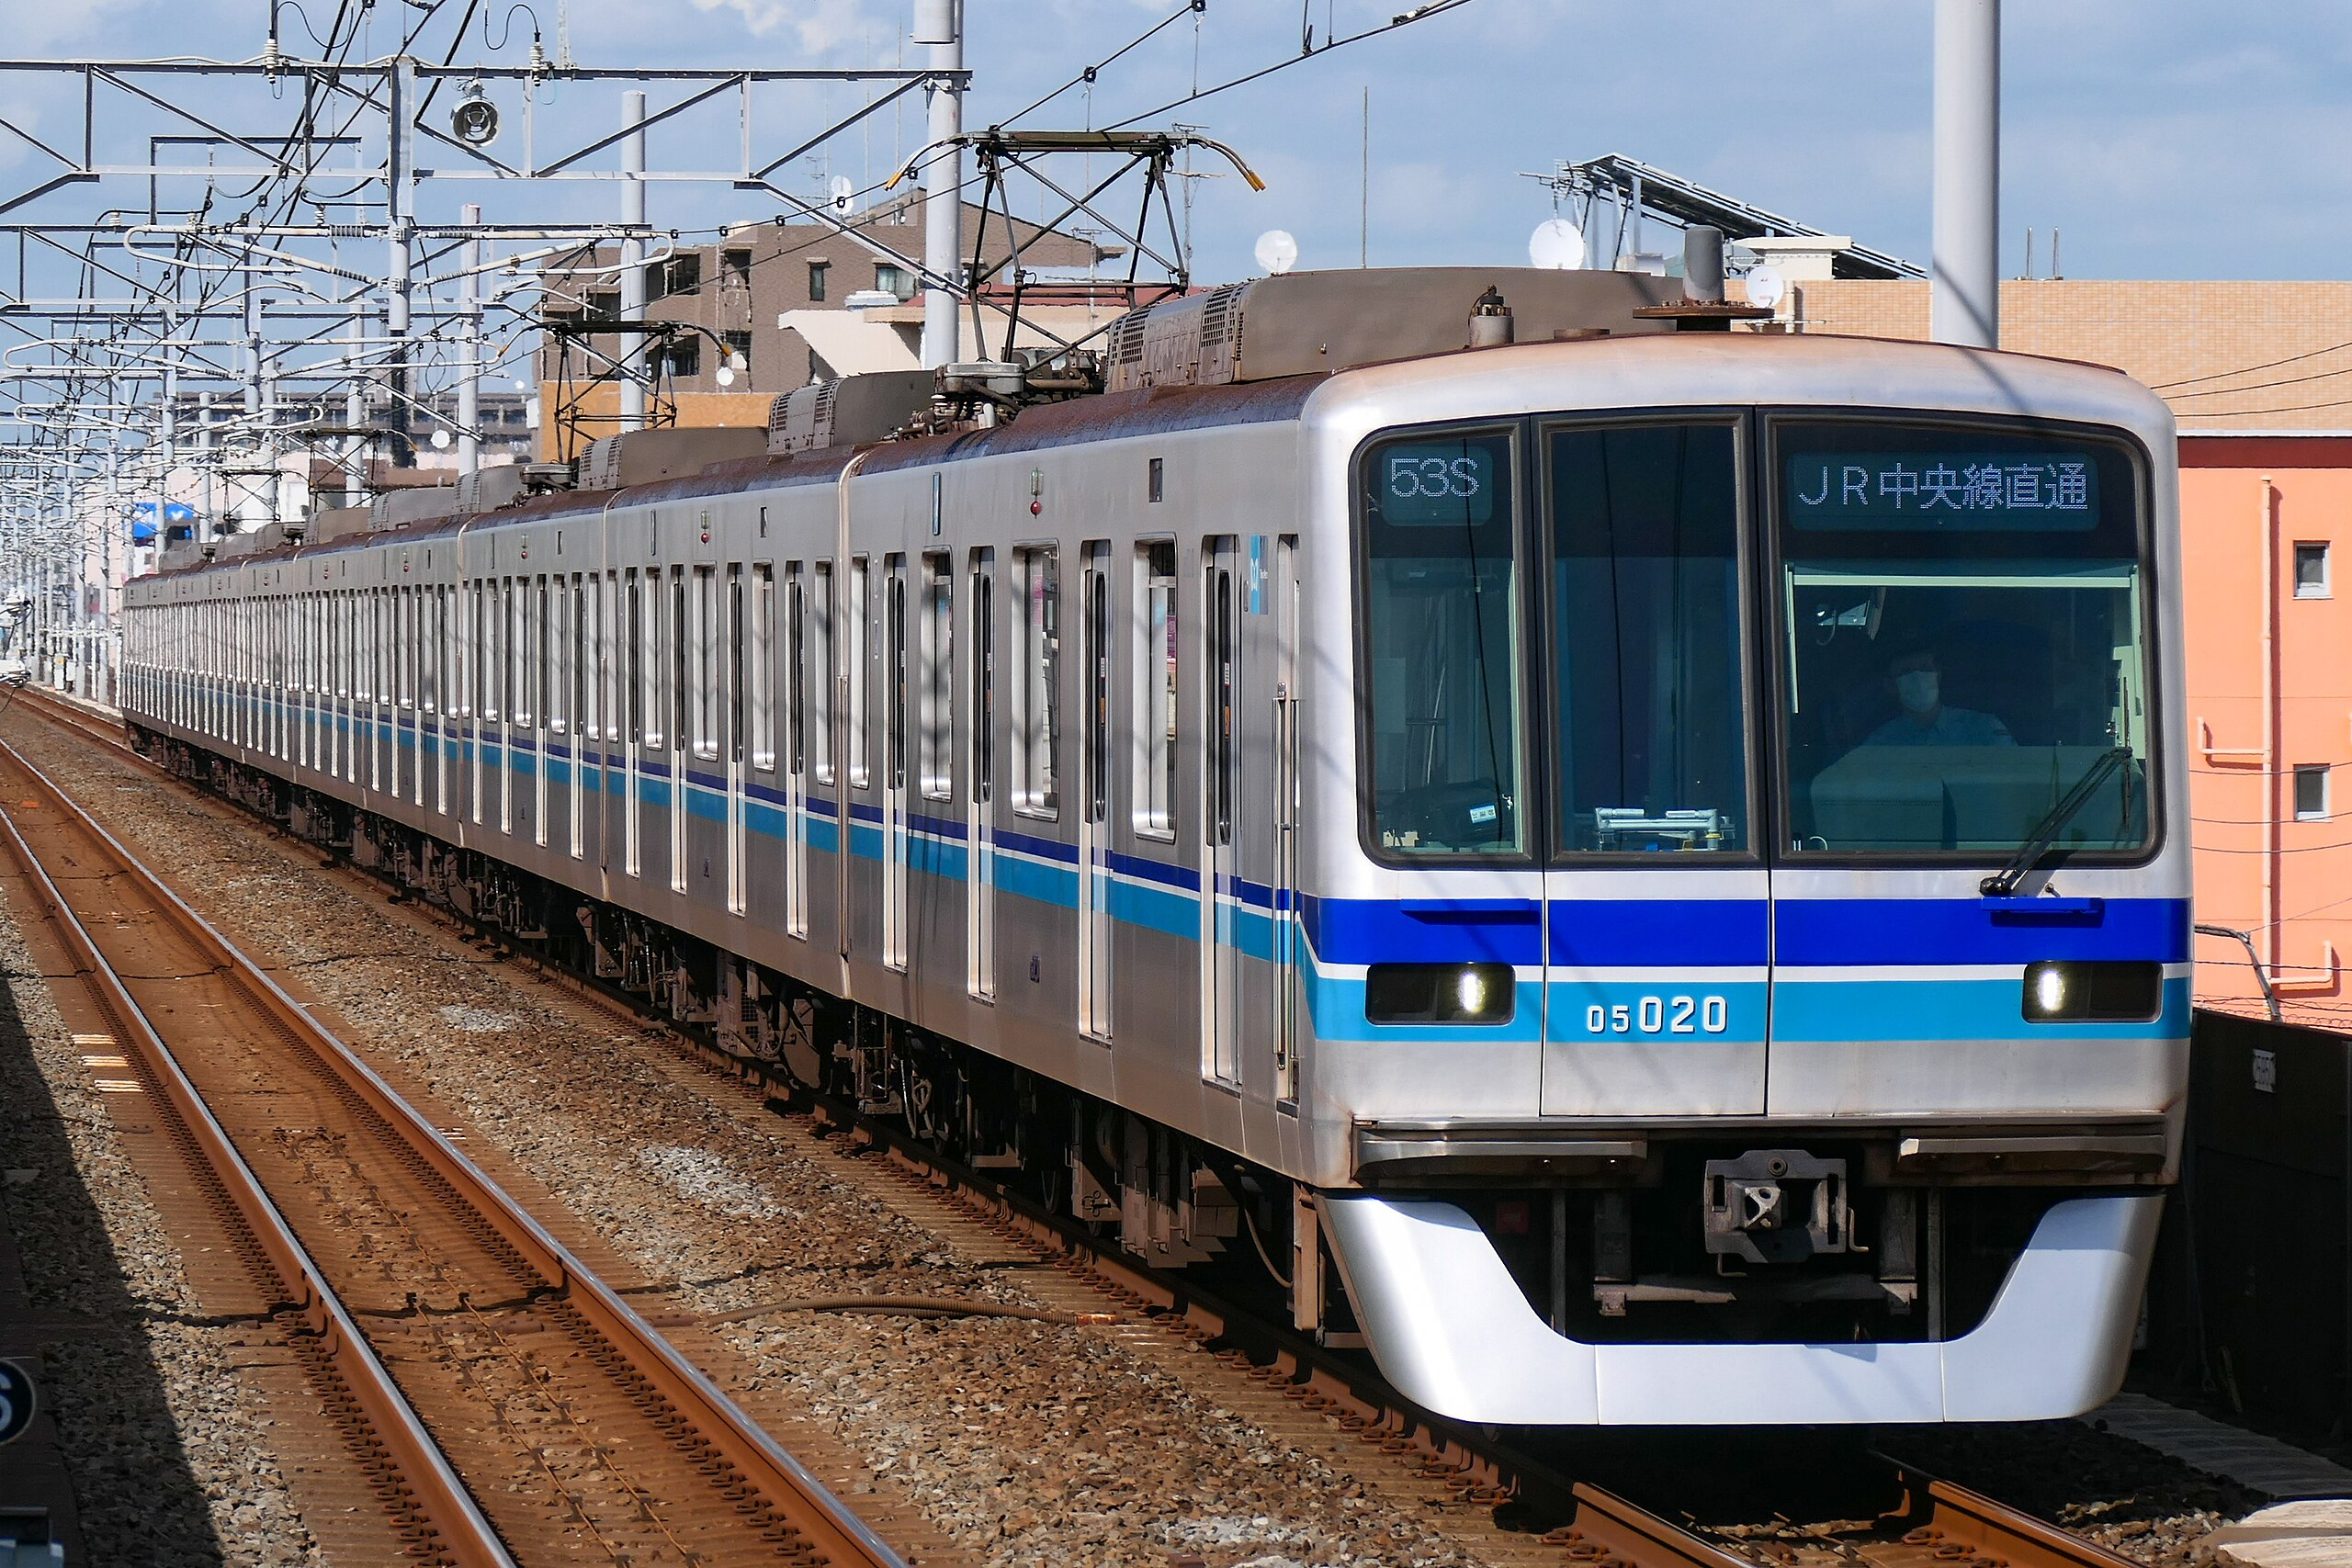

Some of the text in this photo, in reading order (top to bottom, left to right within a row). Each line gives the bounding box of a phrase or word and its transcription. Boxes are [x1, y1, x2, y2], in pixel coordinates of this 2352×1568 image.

[1391, 457, 1479, 497] 53S
[1799, 462, 2088, 510] JR中央線直通
